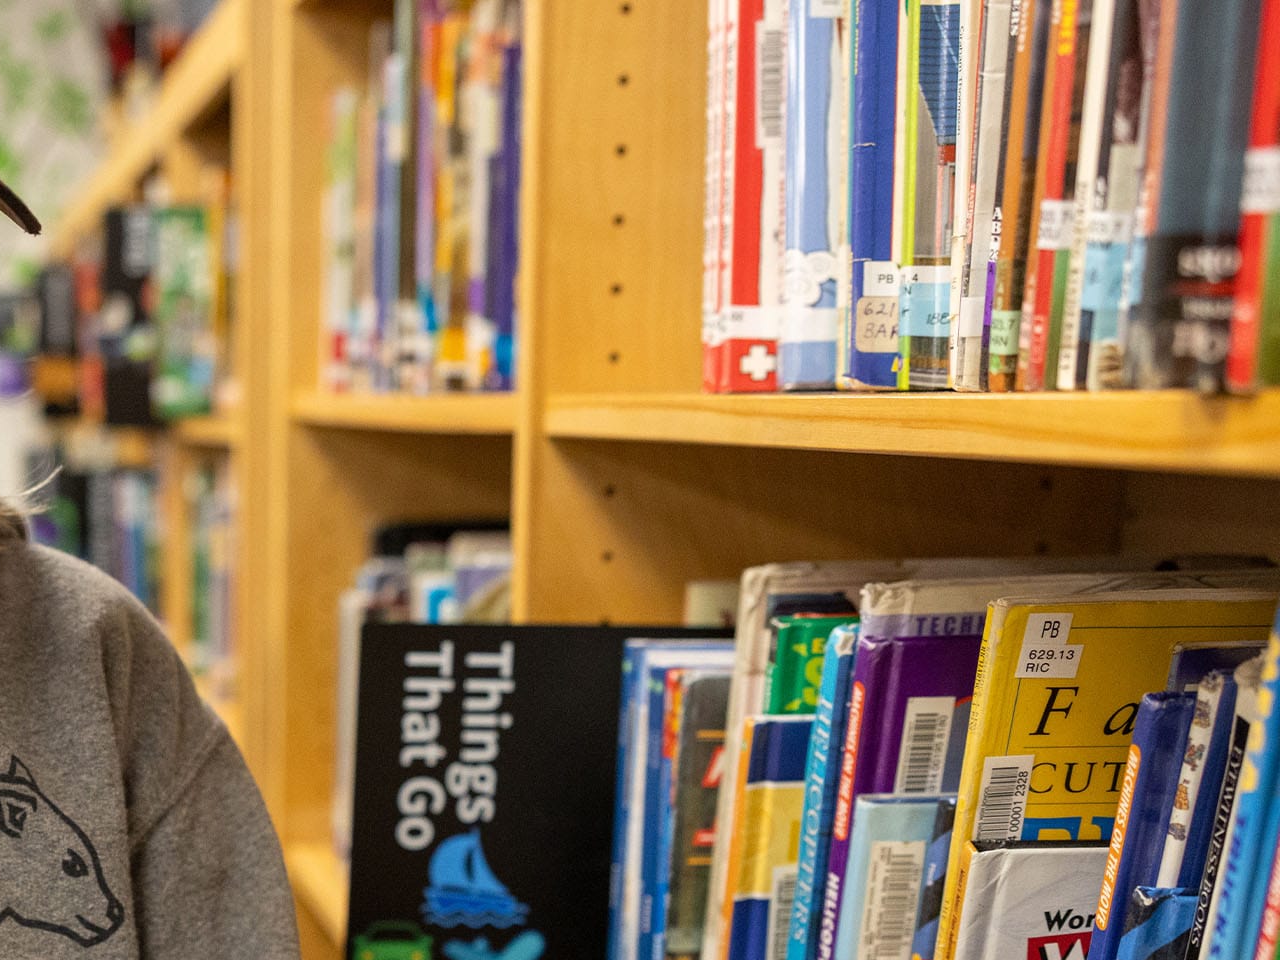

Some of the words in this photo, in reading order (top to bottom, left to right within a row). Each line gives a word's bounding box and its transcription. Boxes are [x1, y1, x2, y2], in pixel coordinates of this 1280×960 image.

[878, 275, 894, 283] PB
[864, 302, 895, 316] 621
[1041, 620, 1060, 638] PB
[1026, 663, 1050, 673] RIC
[1029, 650, 1075, 660] 629.13
[400, 641, 454, 768] That
[445, 641, 515, 824] Things
[1015, 771, 1028, 796] 2328
[1029, 762, 1126, 793] CUT
[1116, 752, 1138, 826] MACHINES
[395, 776, 447, 852] Go
[793, 697, 833, 944] HELICOPTERS
[1011, 801, 1022, 832] 00001
[1206, 746, 1241, 880] EYEWITNESS
[1112, 829, 1123, 852] ON
[1106, 853, 1119, 877] THE
[1096, 882, 1114, 927] MOVE
[1191, 881, 1212, 947] BOOKS
